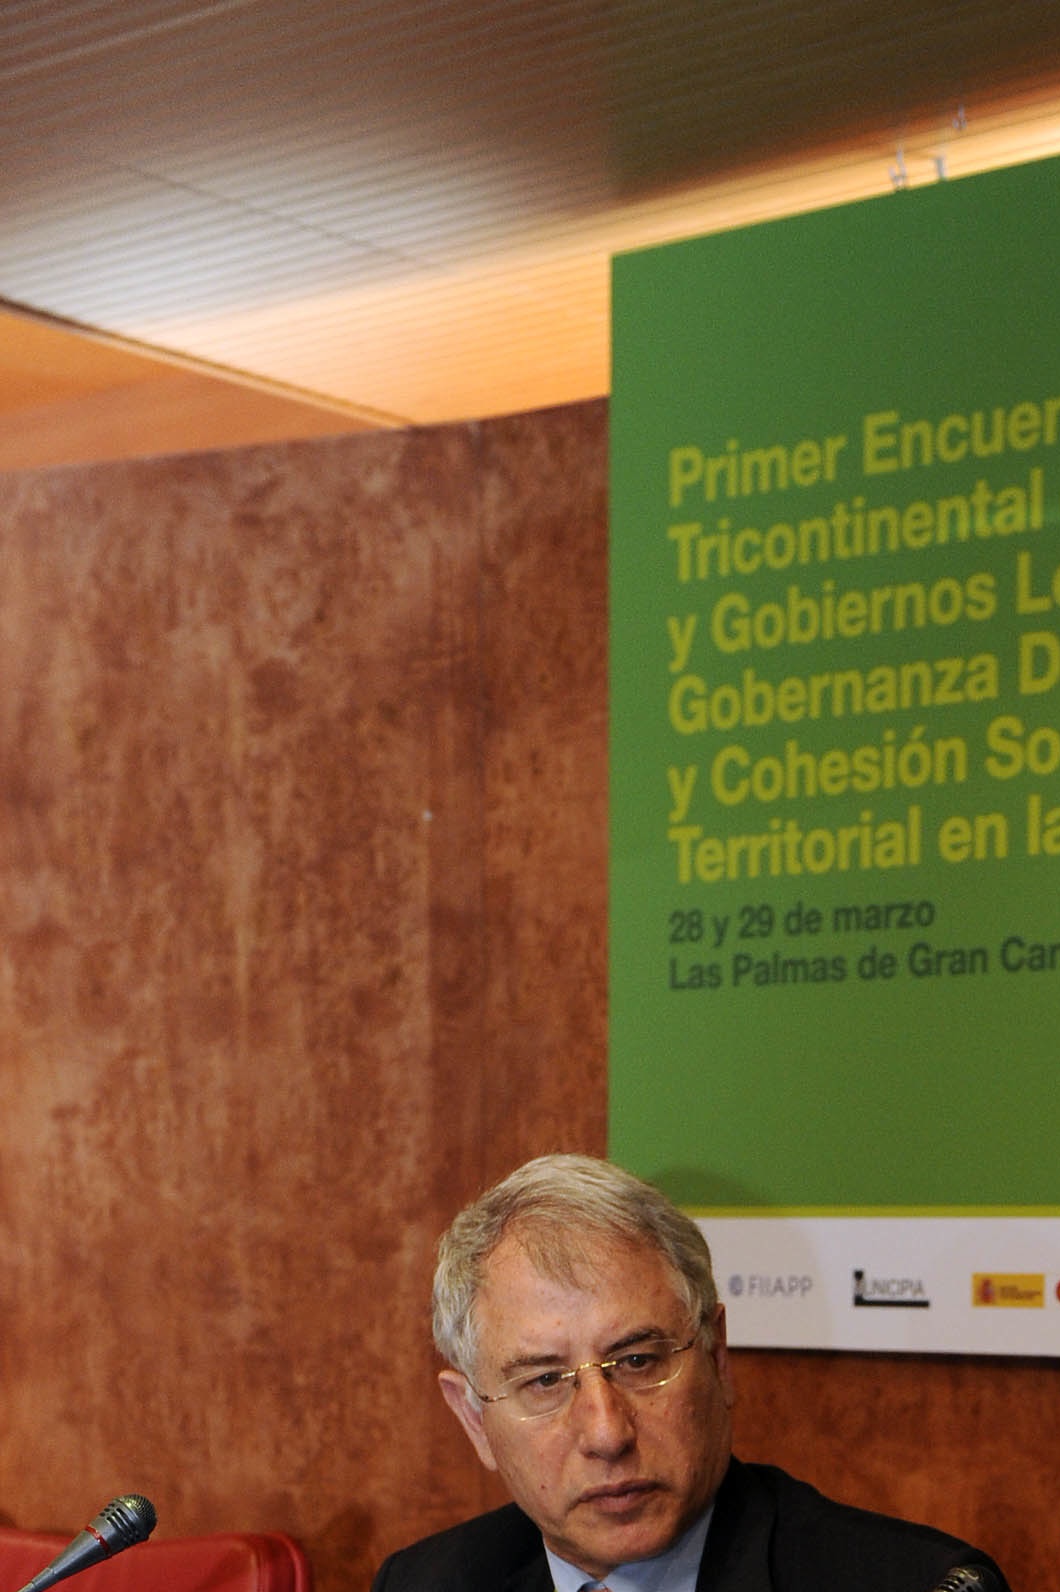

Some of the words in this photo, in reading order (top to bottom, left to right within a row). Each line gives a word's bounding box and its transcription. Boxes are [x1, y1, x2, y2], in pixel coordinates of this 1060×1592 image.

[668, 436, 846, 508] Primer
[667, 466, 1043, 583] Tricontinental
[667, 613, 696, 673] y
[711, 572, 997, 653] Gobiernos
[668, 652, 998, 735] Gobernanza
[667, 765, 696, 823] y
[711, 725, 966, 806] Cohesión
[668, 805, 921, 884] Territorial
[938, 812, 1008, 863] en
[669, 909, 702, 944] 28
[713, 911, 730, 947] y
[738, 904, 774, 940] 29
[783, 901, 823, 936] de
[834, 900, 935, 932] marzo
[669, 957, 722, 990] Las
[733, 949, 847, 987] Palmas
[857, 946, 896, 980] de
[908, 942, 988, 978] Gran
